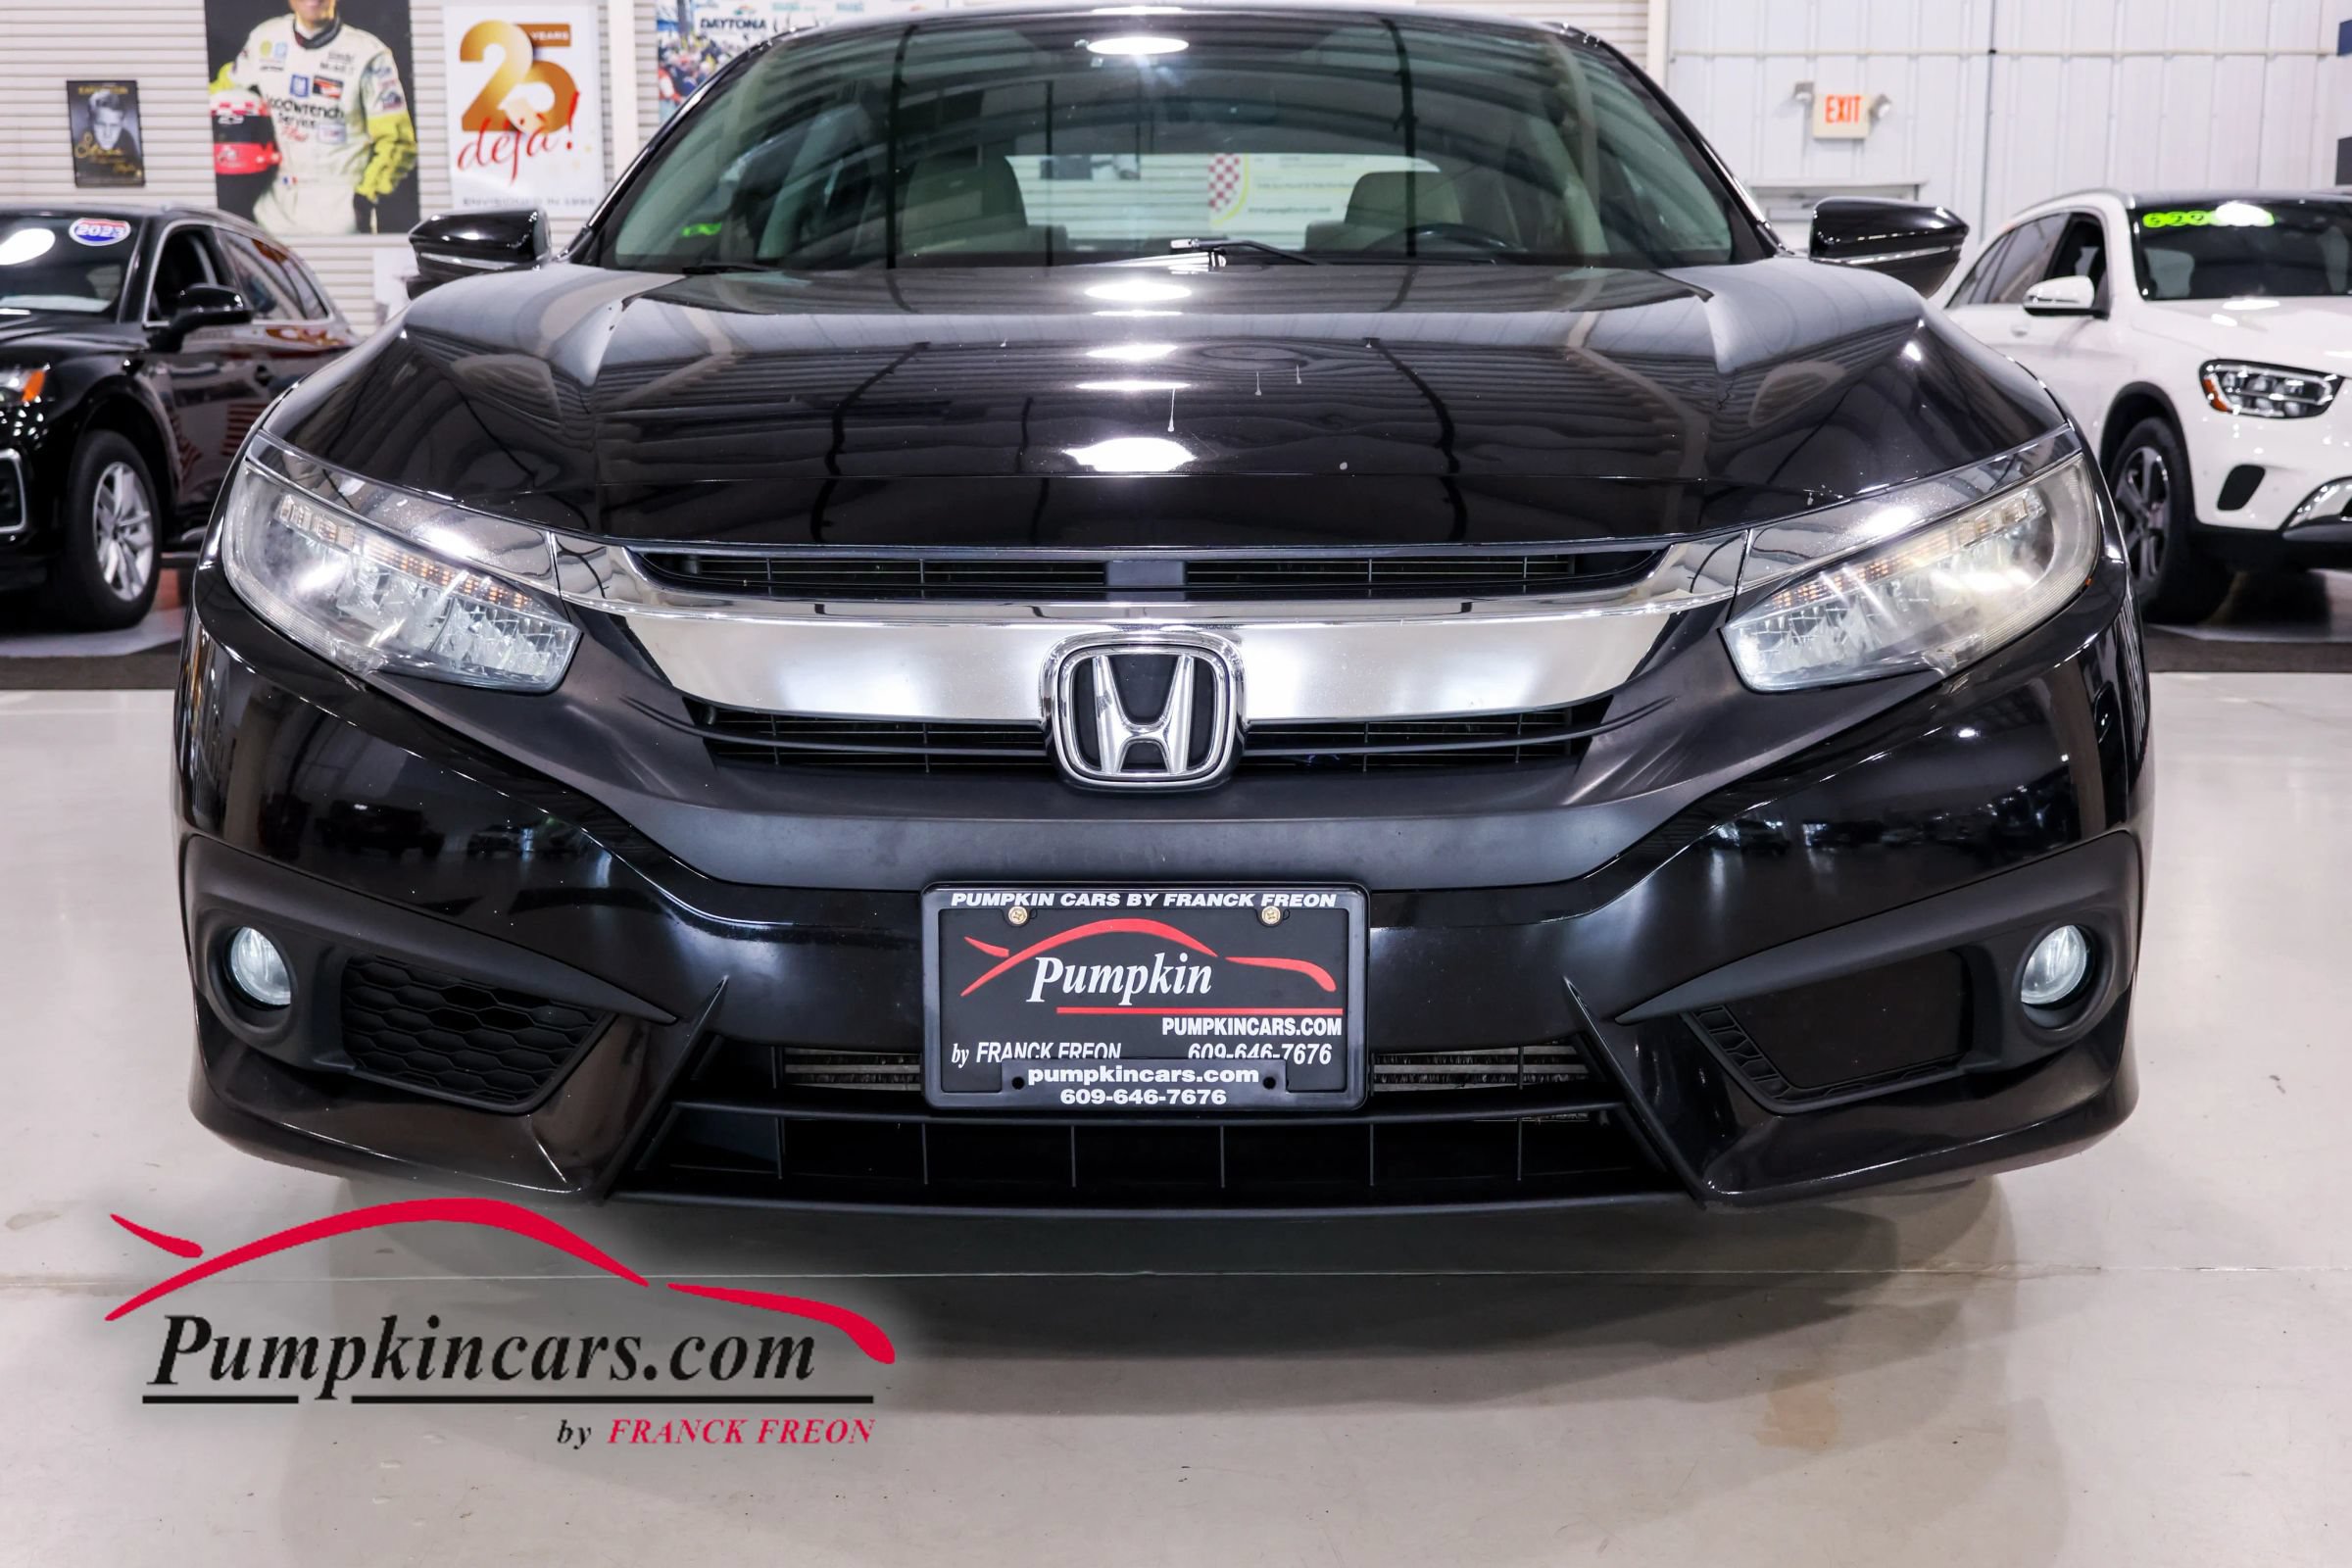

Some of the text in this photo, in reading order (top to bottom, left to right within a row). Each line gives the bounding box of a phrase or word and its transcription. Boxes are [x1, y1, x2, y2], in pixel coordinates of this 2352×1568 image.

[700, 18, 766, 30] DAYTONA
[1825, 94, 1863, 124] EXIT
[951, 893, 1337, 907] PUMPKIN CARS BY FRANCK FREON
[1026, 952, 1212, 1005] Pumpkin
[1162, 1017, 1342, 1036] PUMPKINCARS.COM
[952, 1043, 969, 1068] by
[1188, 1043, 1333, 1064] 609-646-7676
[1028, 1065, 1258, 1085] pumpkincars.com
[1060, 1089, 1227, 1104] 609-646-7676
